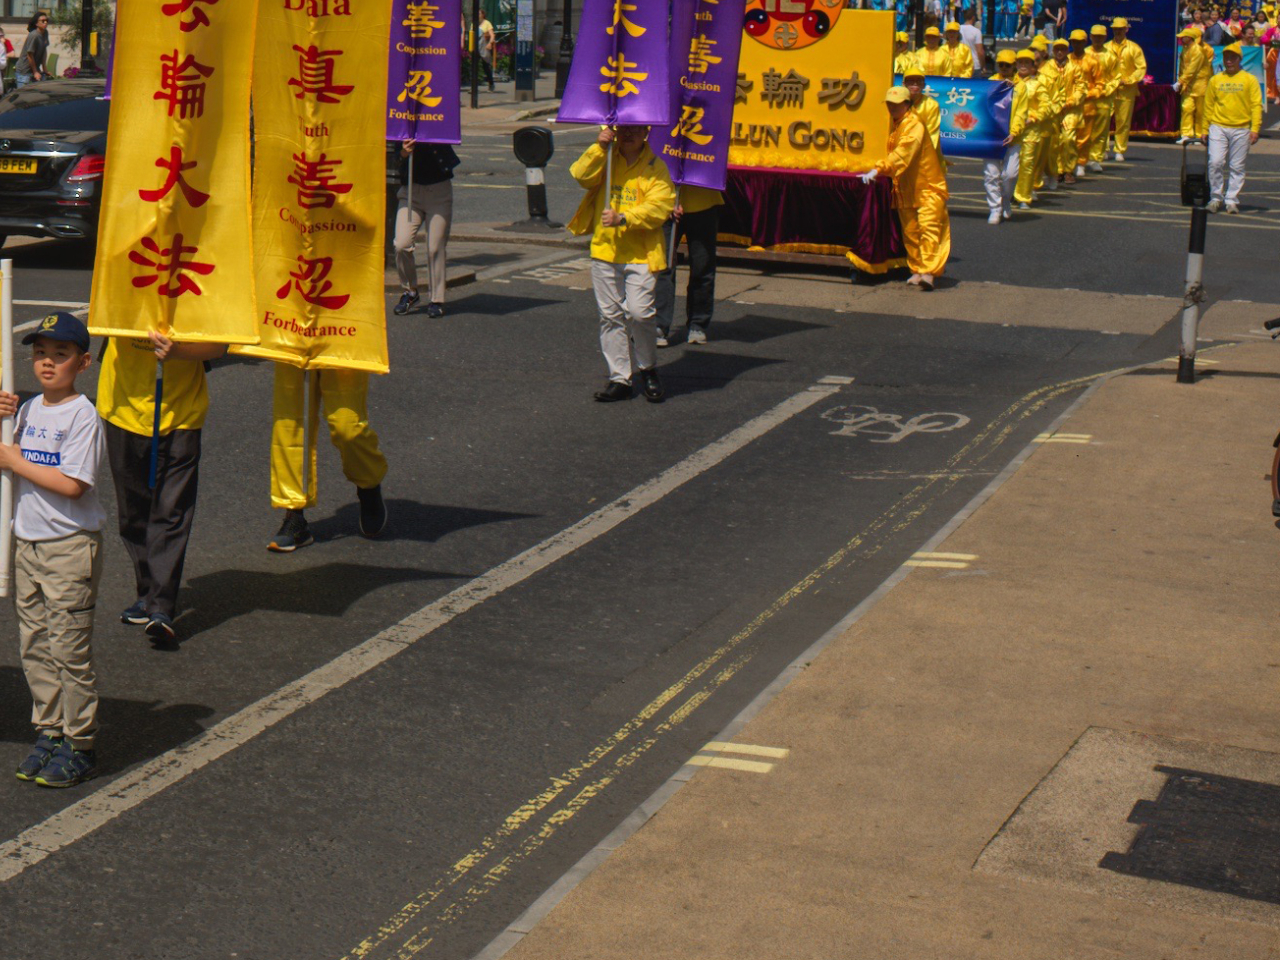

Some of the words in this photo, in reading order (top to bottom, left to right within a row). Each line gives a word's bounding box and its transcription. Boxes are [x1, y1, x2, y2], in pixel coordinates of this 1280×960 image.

[402, 0, 446, 39] 善
[287, 44, 355, 104] 真
[397, 70, 443, 108] 忍
[731, 121, 782, 148] LUN
[940, 131, 967, 140] RCISES
[287, 151, 354, 210] 善
[276, 254, 351, 310] 忍
[263, 311, 357, 338] Forbearance
